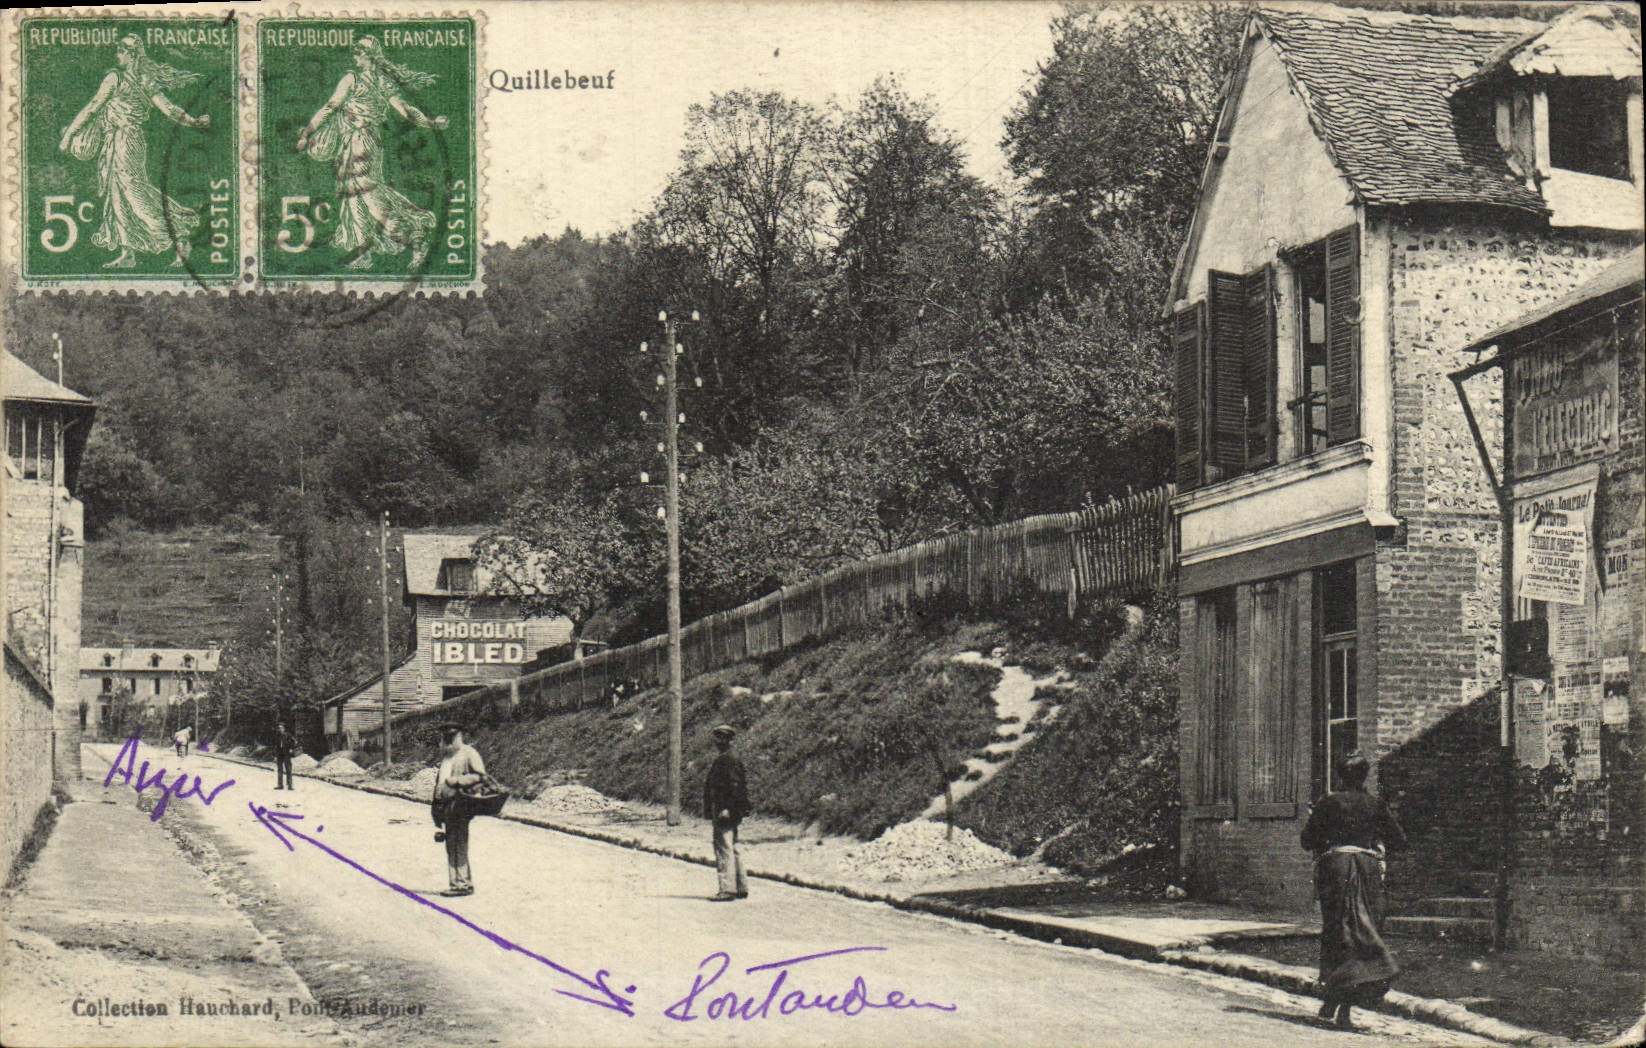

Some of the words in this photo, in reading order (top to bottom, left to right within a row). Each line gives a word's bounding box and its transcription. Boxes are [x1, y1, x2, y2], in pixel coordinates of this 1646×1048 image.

[29, 27, 119, 47] REPUBLIQUE
[146, 27, 230, 47] FRANÇAISE
[265, 28, 355, 48] REPUBLIQUE
[383, 28, 466, 48] FRANÇAISE
[210, 178, 230, 264] POSTES
[447, 179, 466, 264] POSTES
[1519, 505, 1531, 523] Le
[1558, 489, 1592, 511] Journal
[431, 622, 527, 639] CHOCOLAT
[433, 642, 523, 663] IBLED
